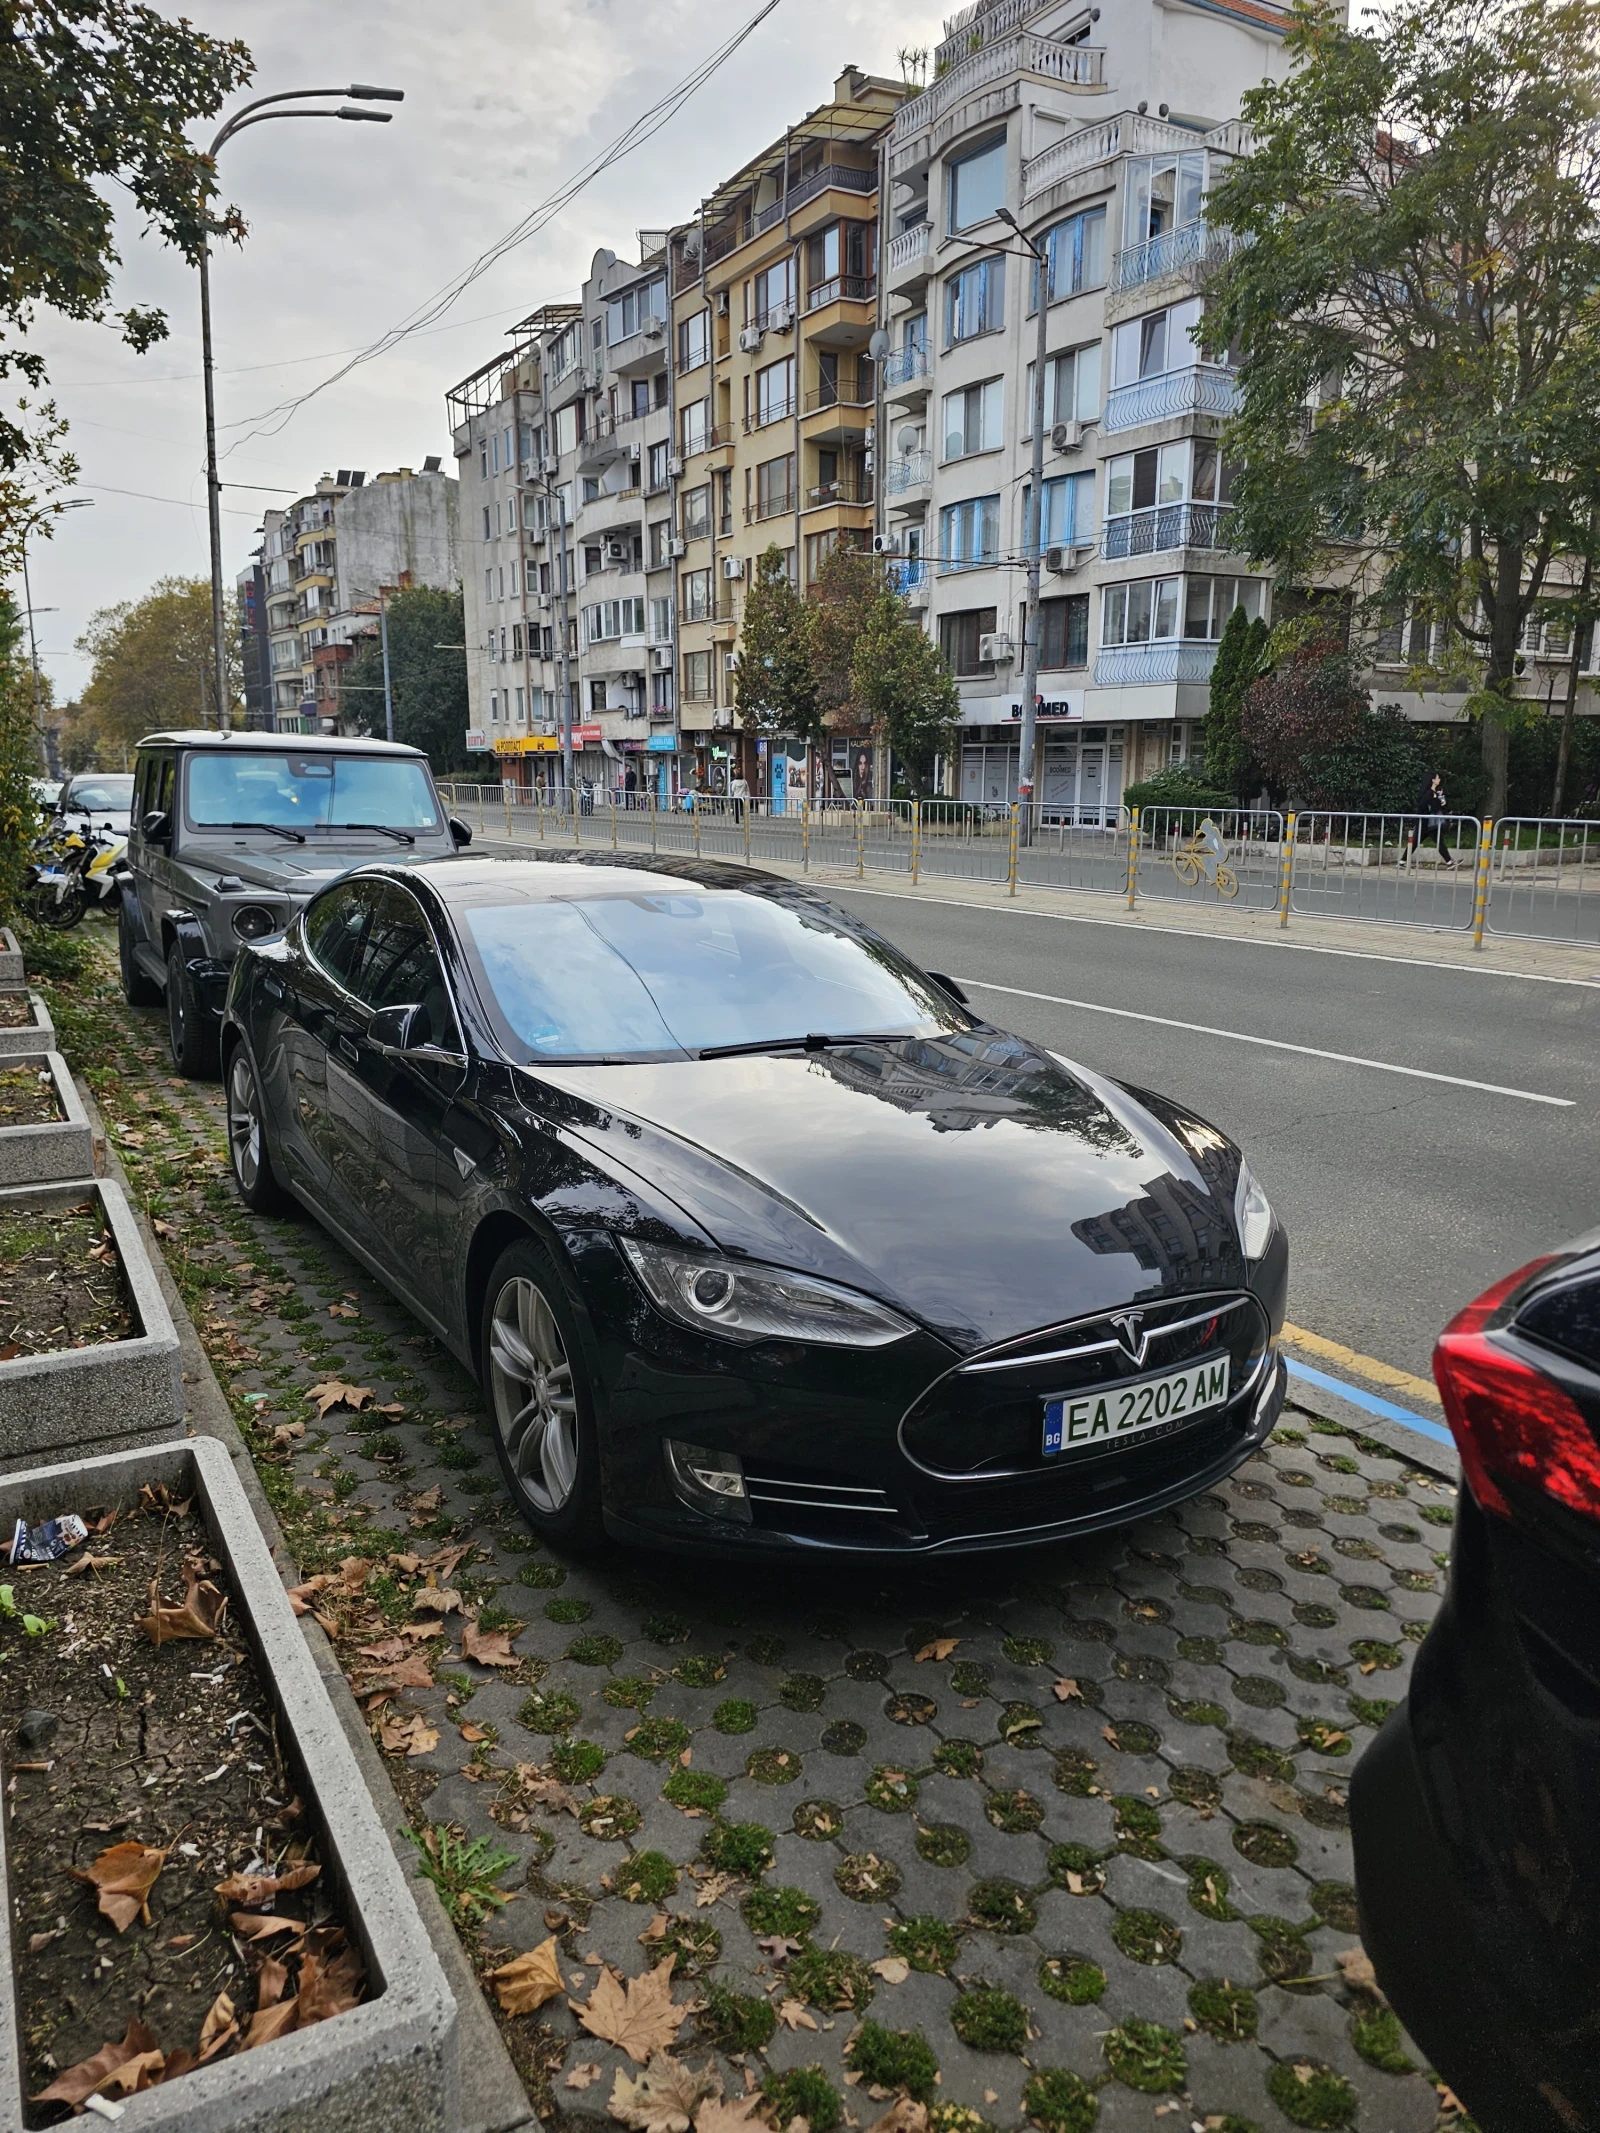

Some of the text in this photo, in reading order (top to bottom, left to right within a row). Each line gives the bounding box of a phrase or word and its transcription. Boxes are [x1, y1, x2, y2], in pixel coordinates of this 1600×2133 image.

[1011, 695, 1069, 717] BIMED
[1068, 1362, 1226, 1442] EA 2202 AM
[1045, 1432, 1061, 1446] BG
